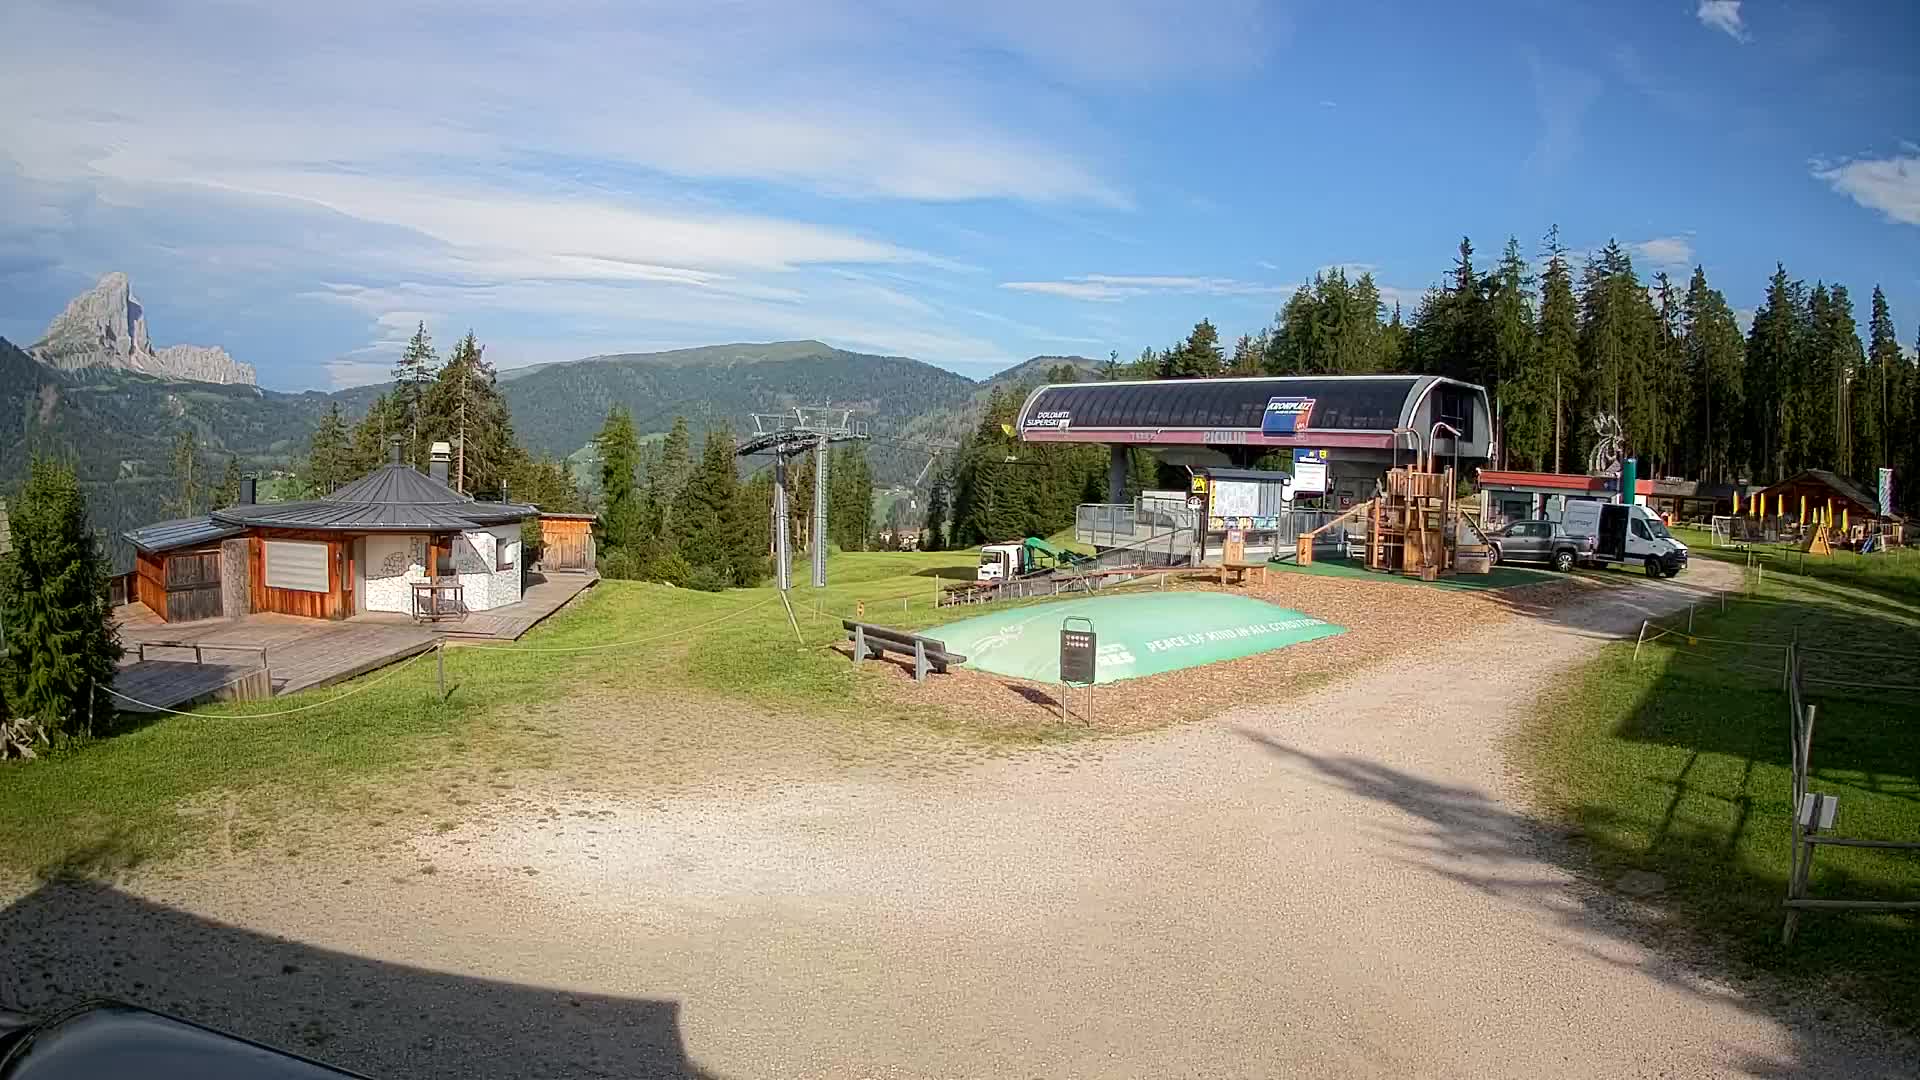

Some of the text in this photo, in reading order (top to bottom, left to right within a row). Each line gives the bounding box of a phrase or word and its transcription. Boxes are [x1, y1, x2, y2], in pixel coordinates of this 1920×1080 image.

[1037, 411, 1070, 419] DOLOMITI
[1145, 634, 1185, 653] PEACE
[1187, 632, 1206, 648] OF
[1205, 629, 1237, 641] MIND
[1234, 626, 1249, 638] IN
[1249, 623, 1270, 636] ALL
